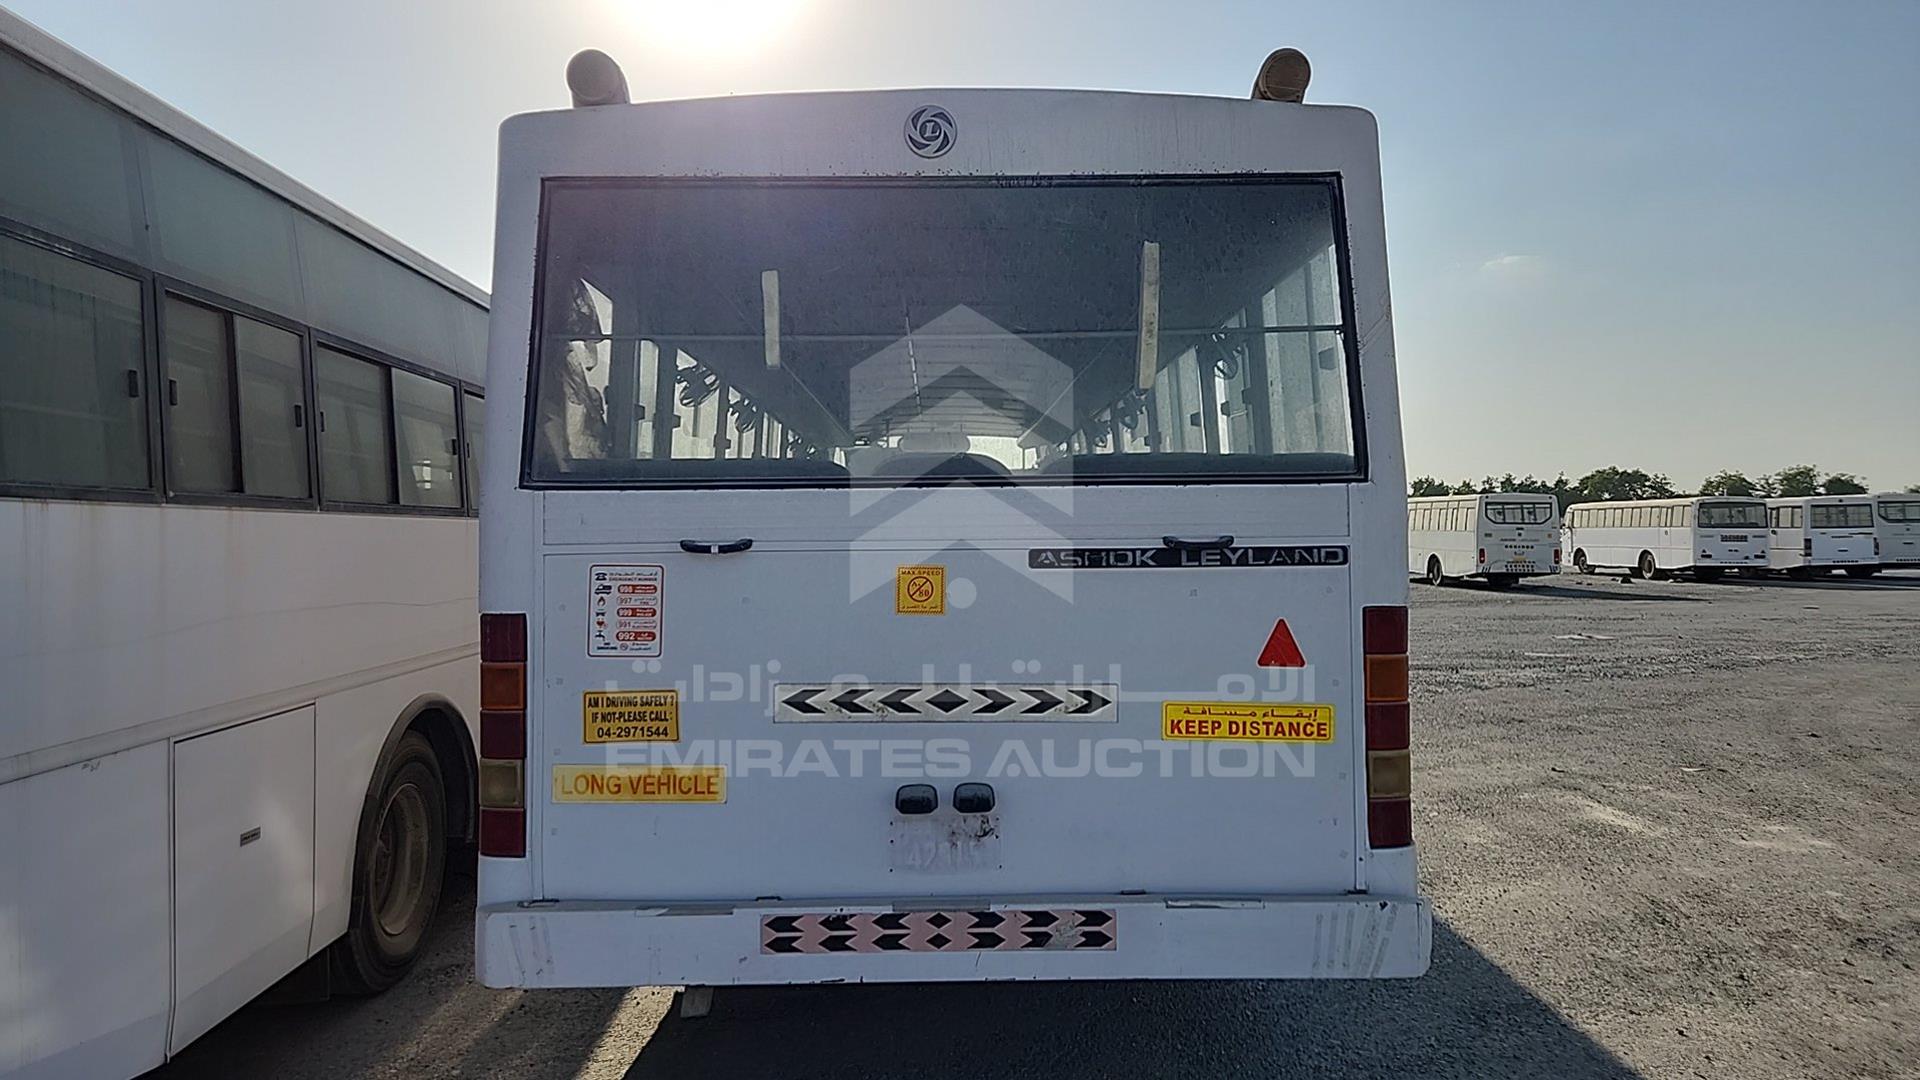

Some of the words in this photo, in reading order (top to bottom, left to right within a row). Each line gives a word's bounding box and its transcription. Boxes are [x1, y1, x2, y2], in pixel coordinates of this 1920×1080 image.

[1032, 548, 1160, 567] ASHOK
[1181, 547, 1344, 567] LEYLAND
[618, 632, 636, 640] 992
[588, 696, 601, 708] AM
[606, 695, 638, 708] DRIVING
[639, 695, 669, 707] SAFELY
[591, 712, 599, 724] IF
[597, 726, 669, 739] 04-2971544
[1170, 720, 1222, 736] KEEP
[1228, 721, 1328, 738] DISTANCE
[562, 774, 622, 795] LONG
[627, 774, 720, 795] VEHICLE
